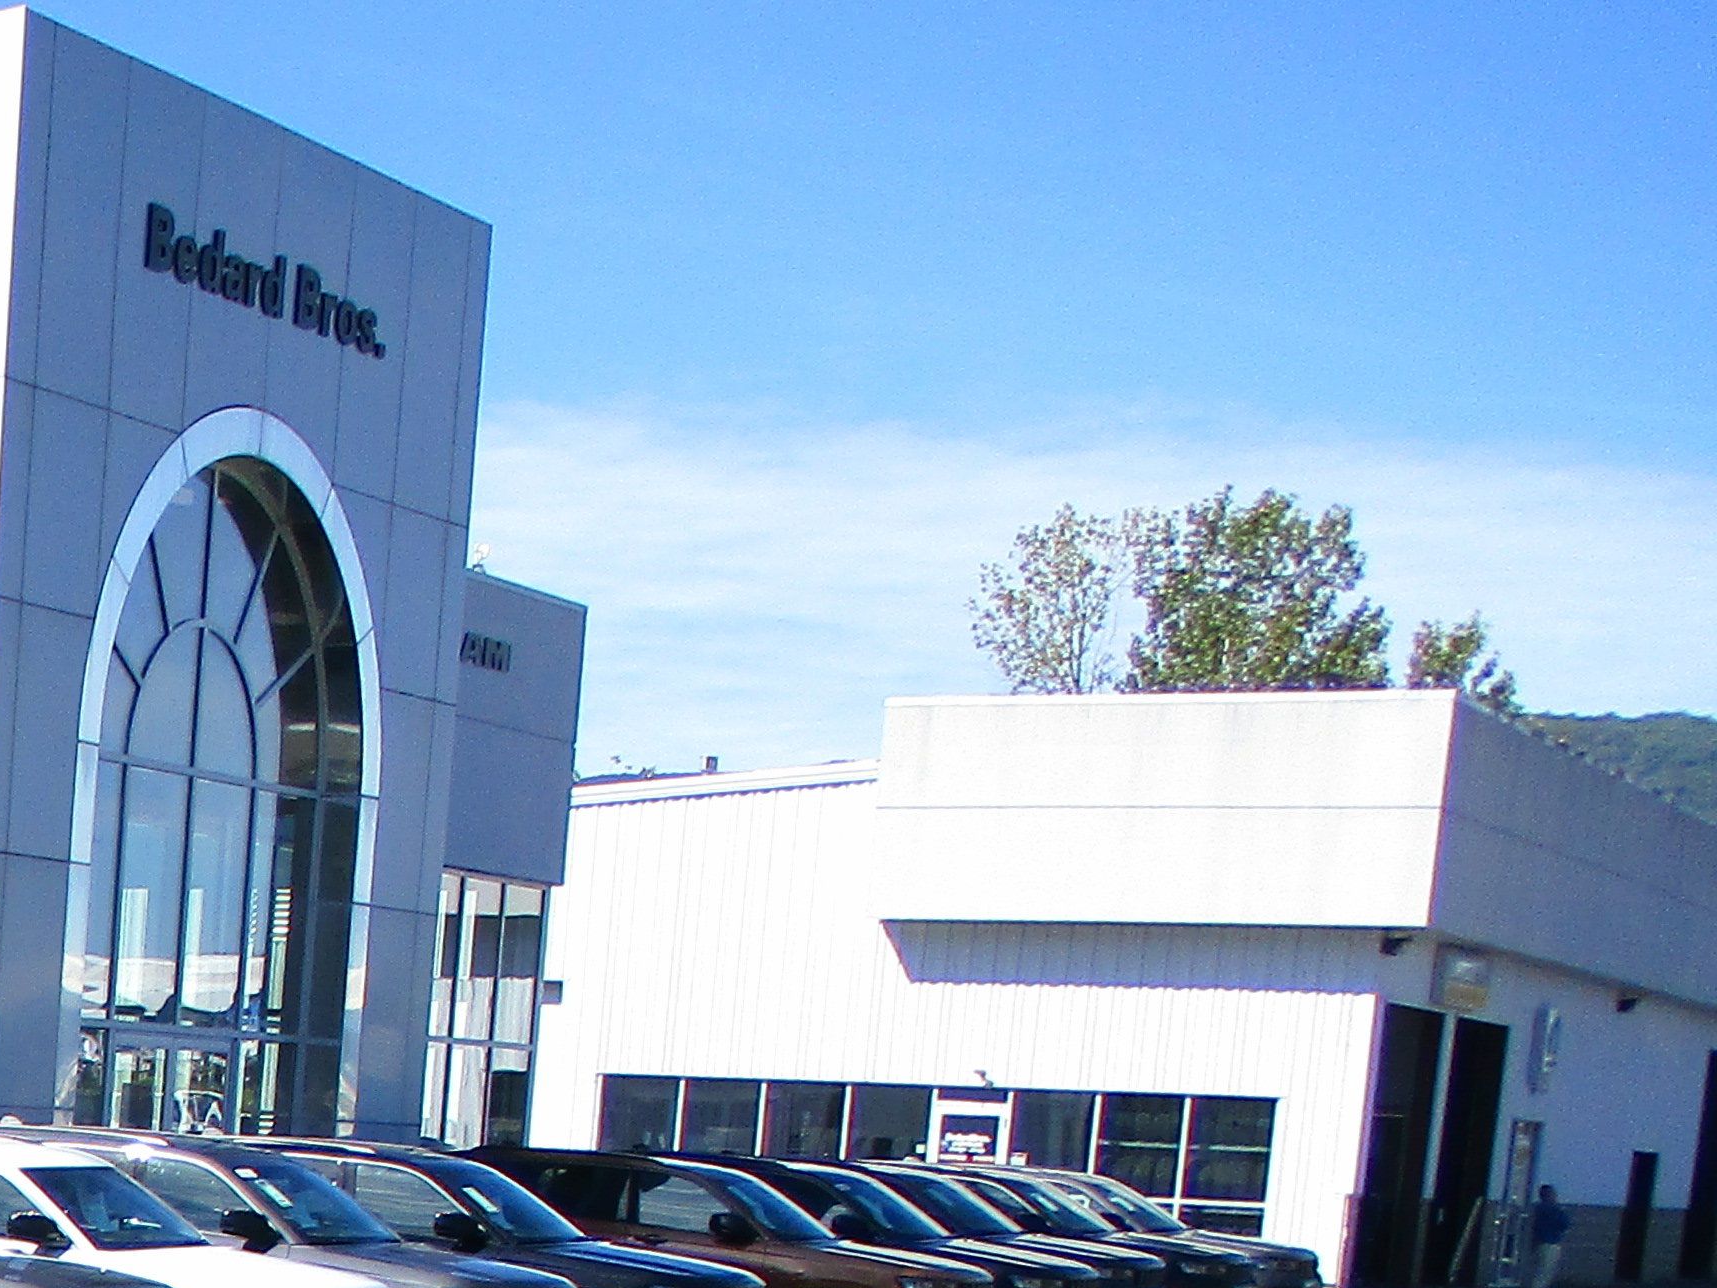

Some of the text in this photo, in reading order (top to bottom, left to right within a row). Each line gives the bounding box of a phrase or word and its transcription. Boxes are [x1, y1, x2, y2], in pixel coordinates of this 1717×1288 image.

[144, 202, 387, 361] Bedard Bros.
[459, 631, 511, 673] AM
